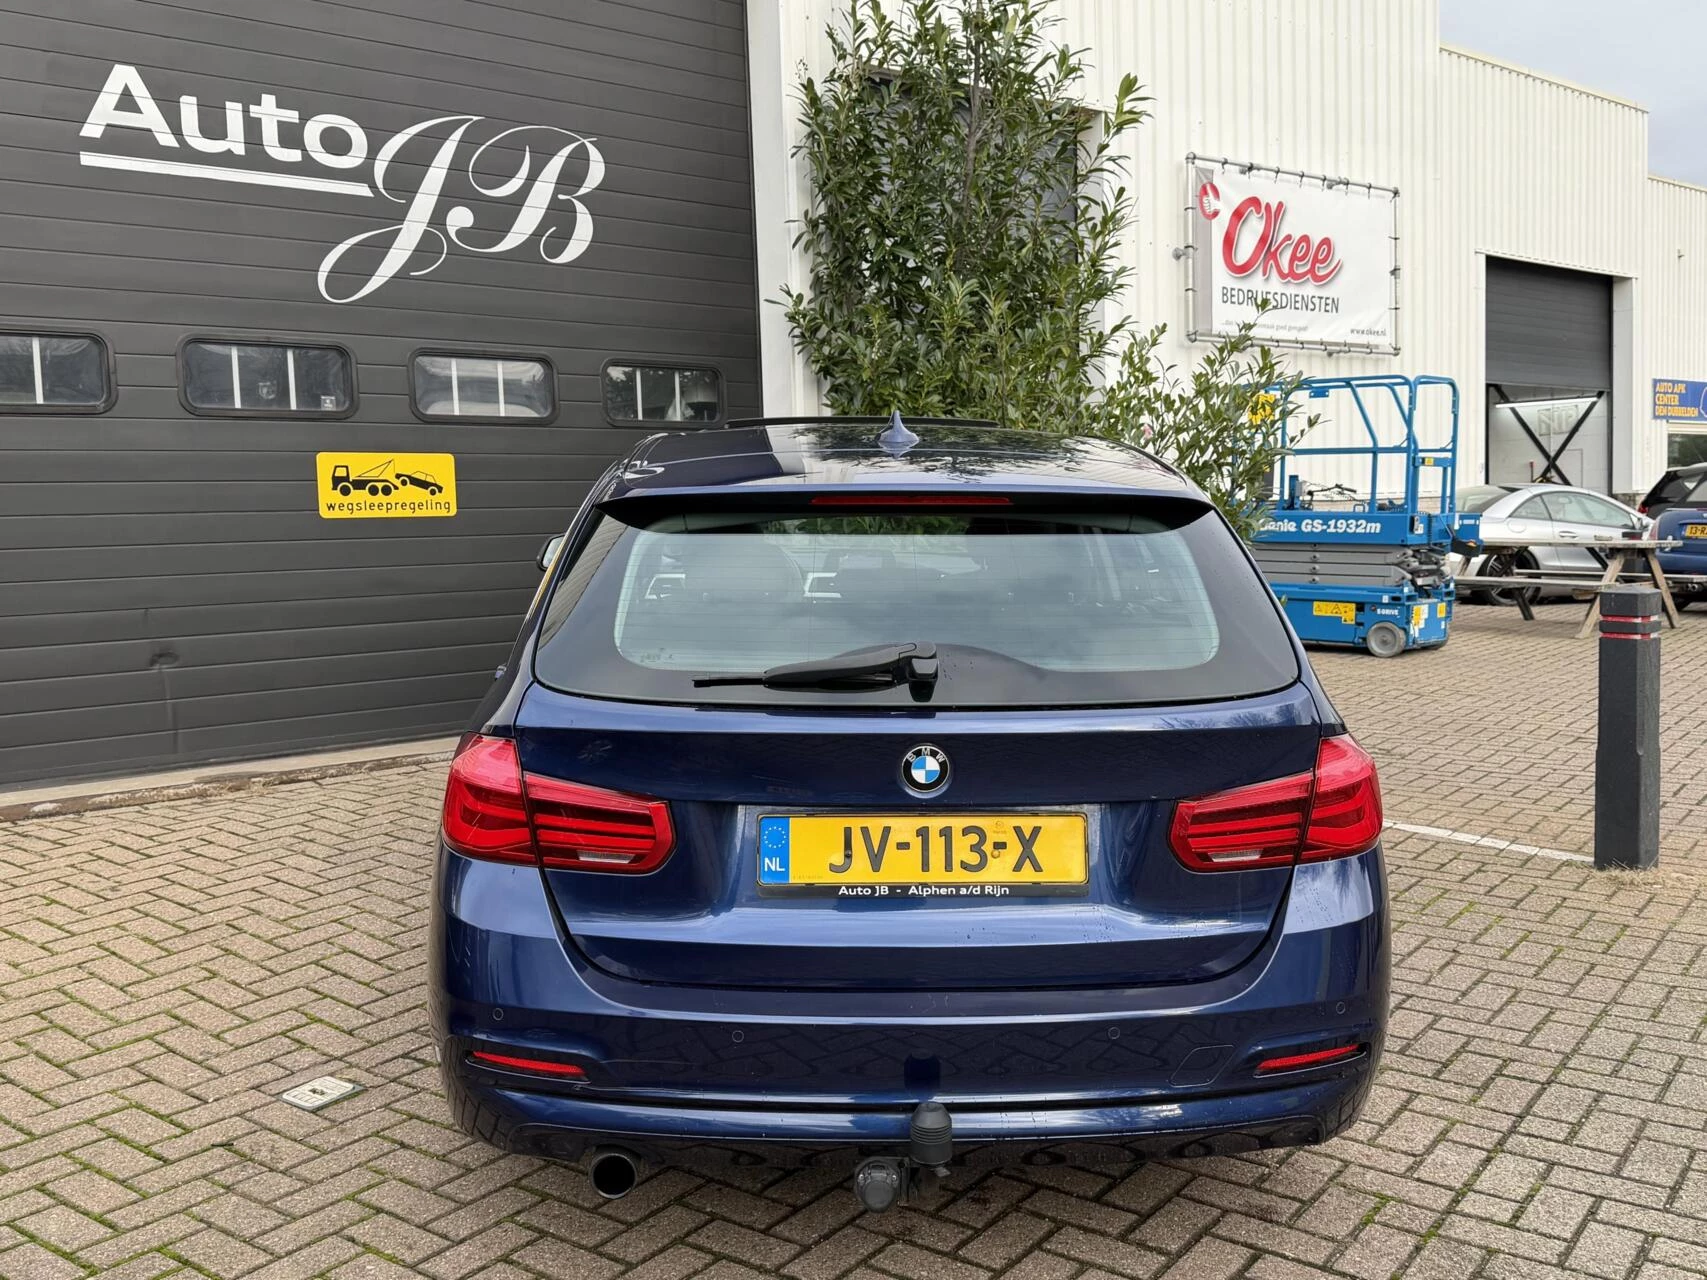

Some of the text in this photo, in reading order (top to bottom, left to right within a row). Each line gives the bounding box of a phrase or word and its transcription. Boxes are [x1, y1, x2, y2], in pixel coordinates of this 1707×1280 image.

[80, 64, 606, 303] Auto JB
[1655, 382, 1673, 393] AUTO
[1655, 393, 1679, 405] CENTER
[326, 499, 451, 515] wegsleepregeling
[1300, 519, 1382, 534] GS-1932m
[906, 746, 946, 763] BMW
[828, 825, 1043, 874] JV-113-X
[763, 857, 786, 872] NL
[838, 885, 872, 896] Auto
[875, 885, 889, 897] JB
[908, 885, 956, 897] Alphen
[959, 885, 982, 896] a/d
[984, 885, 1010, 897] Rijn
